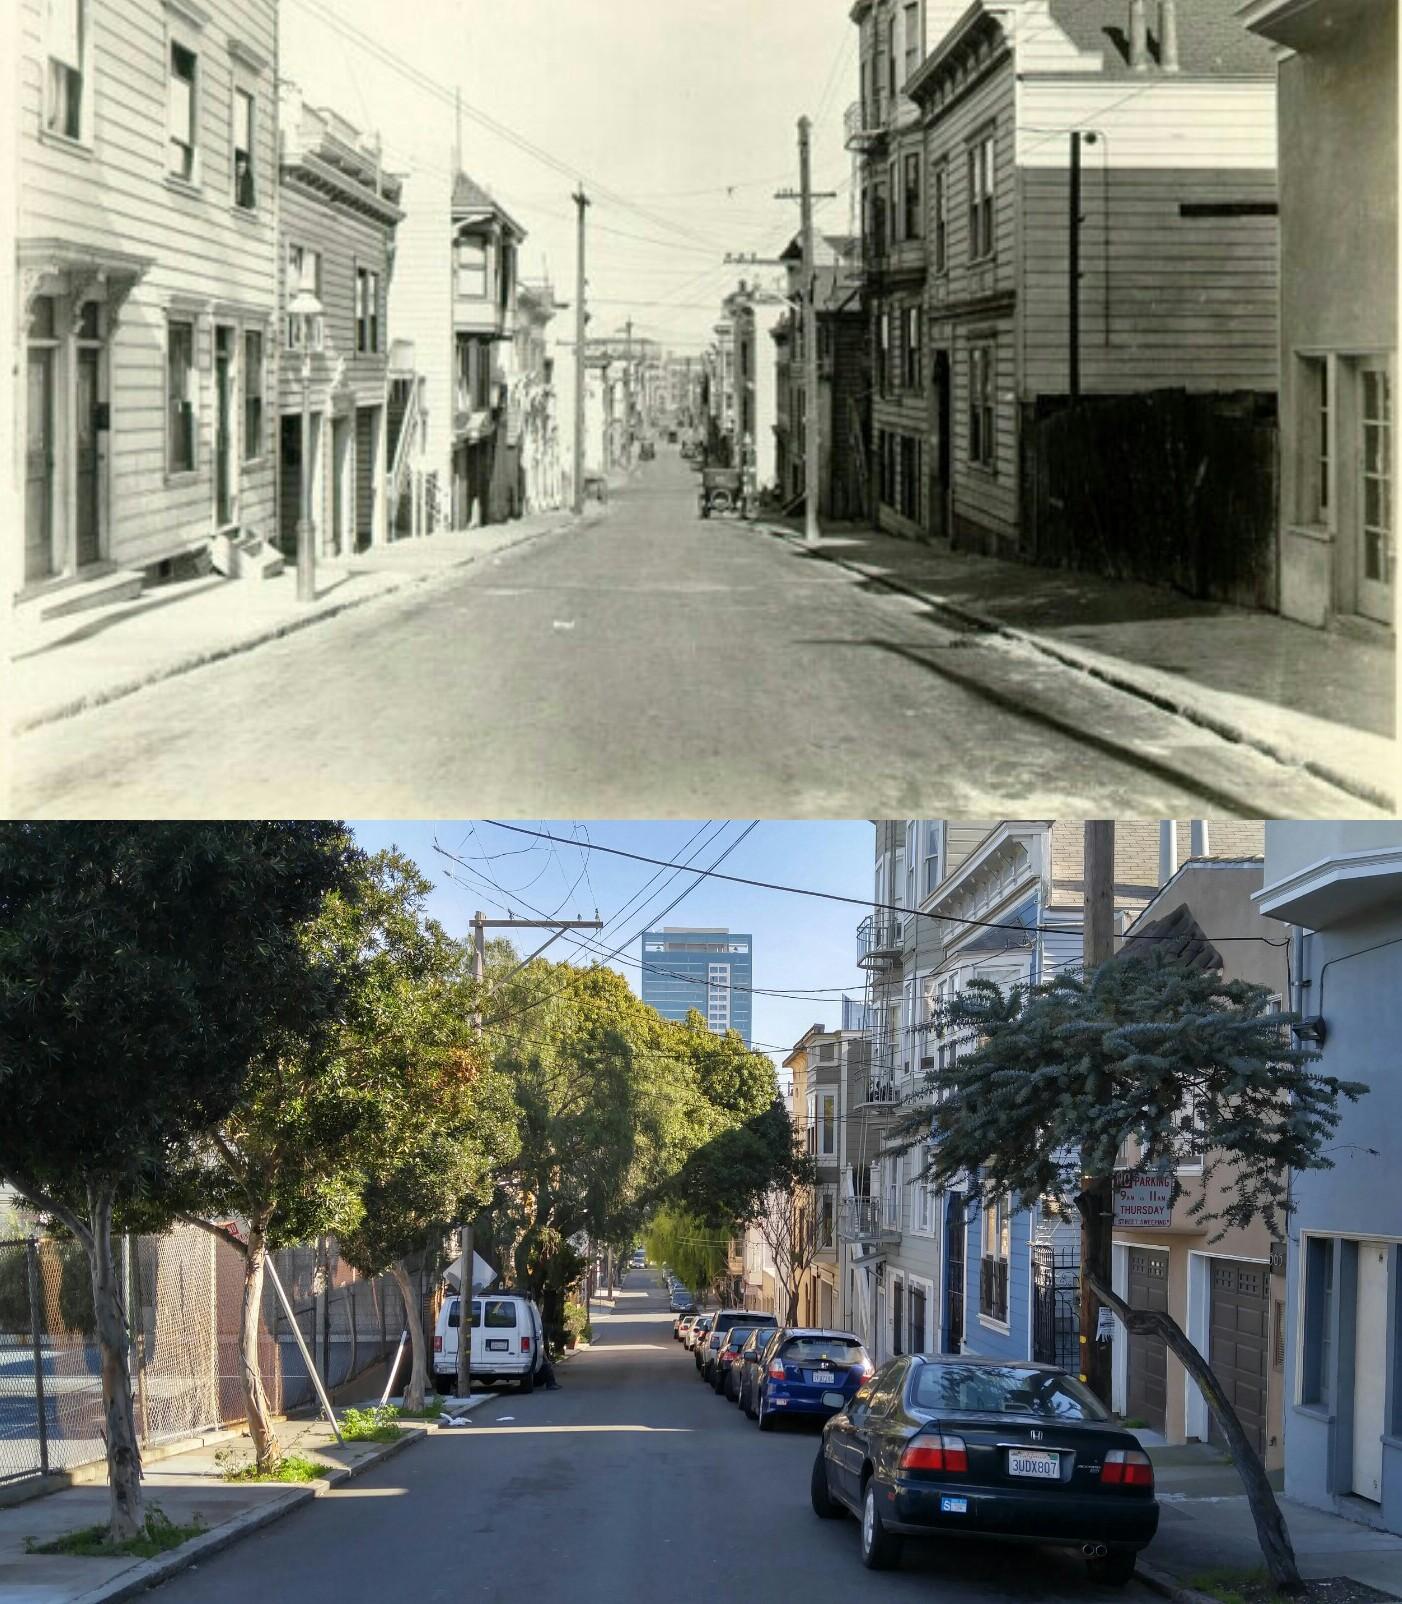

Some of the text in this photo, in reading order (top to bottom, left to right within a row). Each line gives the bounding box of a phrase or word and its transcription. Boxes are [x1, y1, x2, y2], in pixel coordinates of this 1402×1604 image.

[1134, 1176, 1170, 1187] PARKING
[1120, 1205, 1165, 1215] THURSDAY
[1012, 1459, 1057, 1475] 3UDX807
